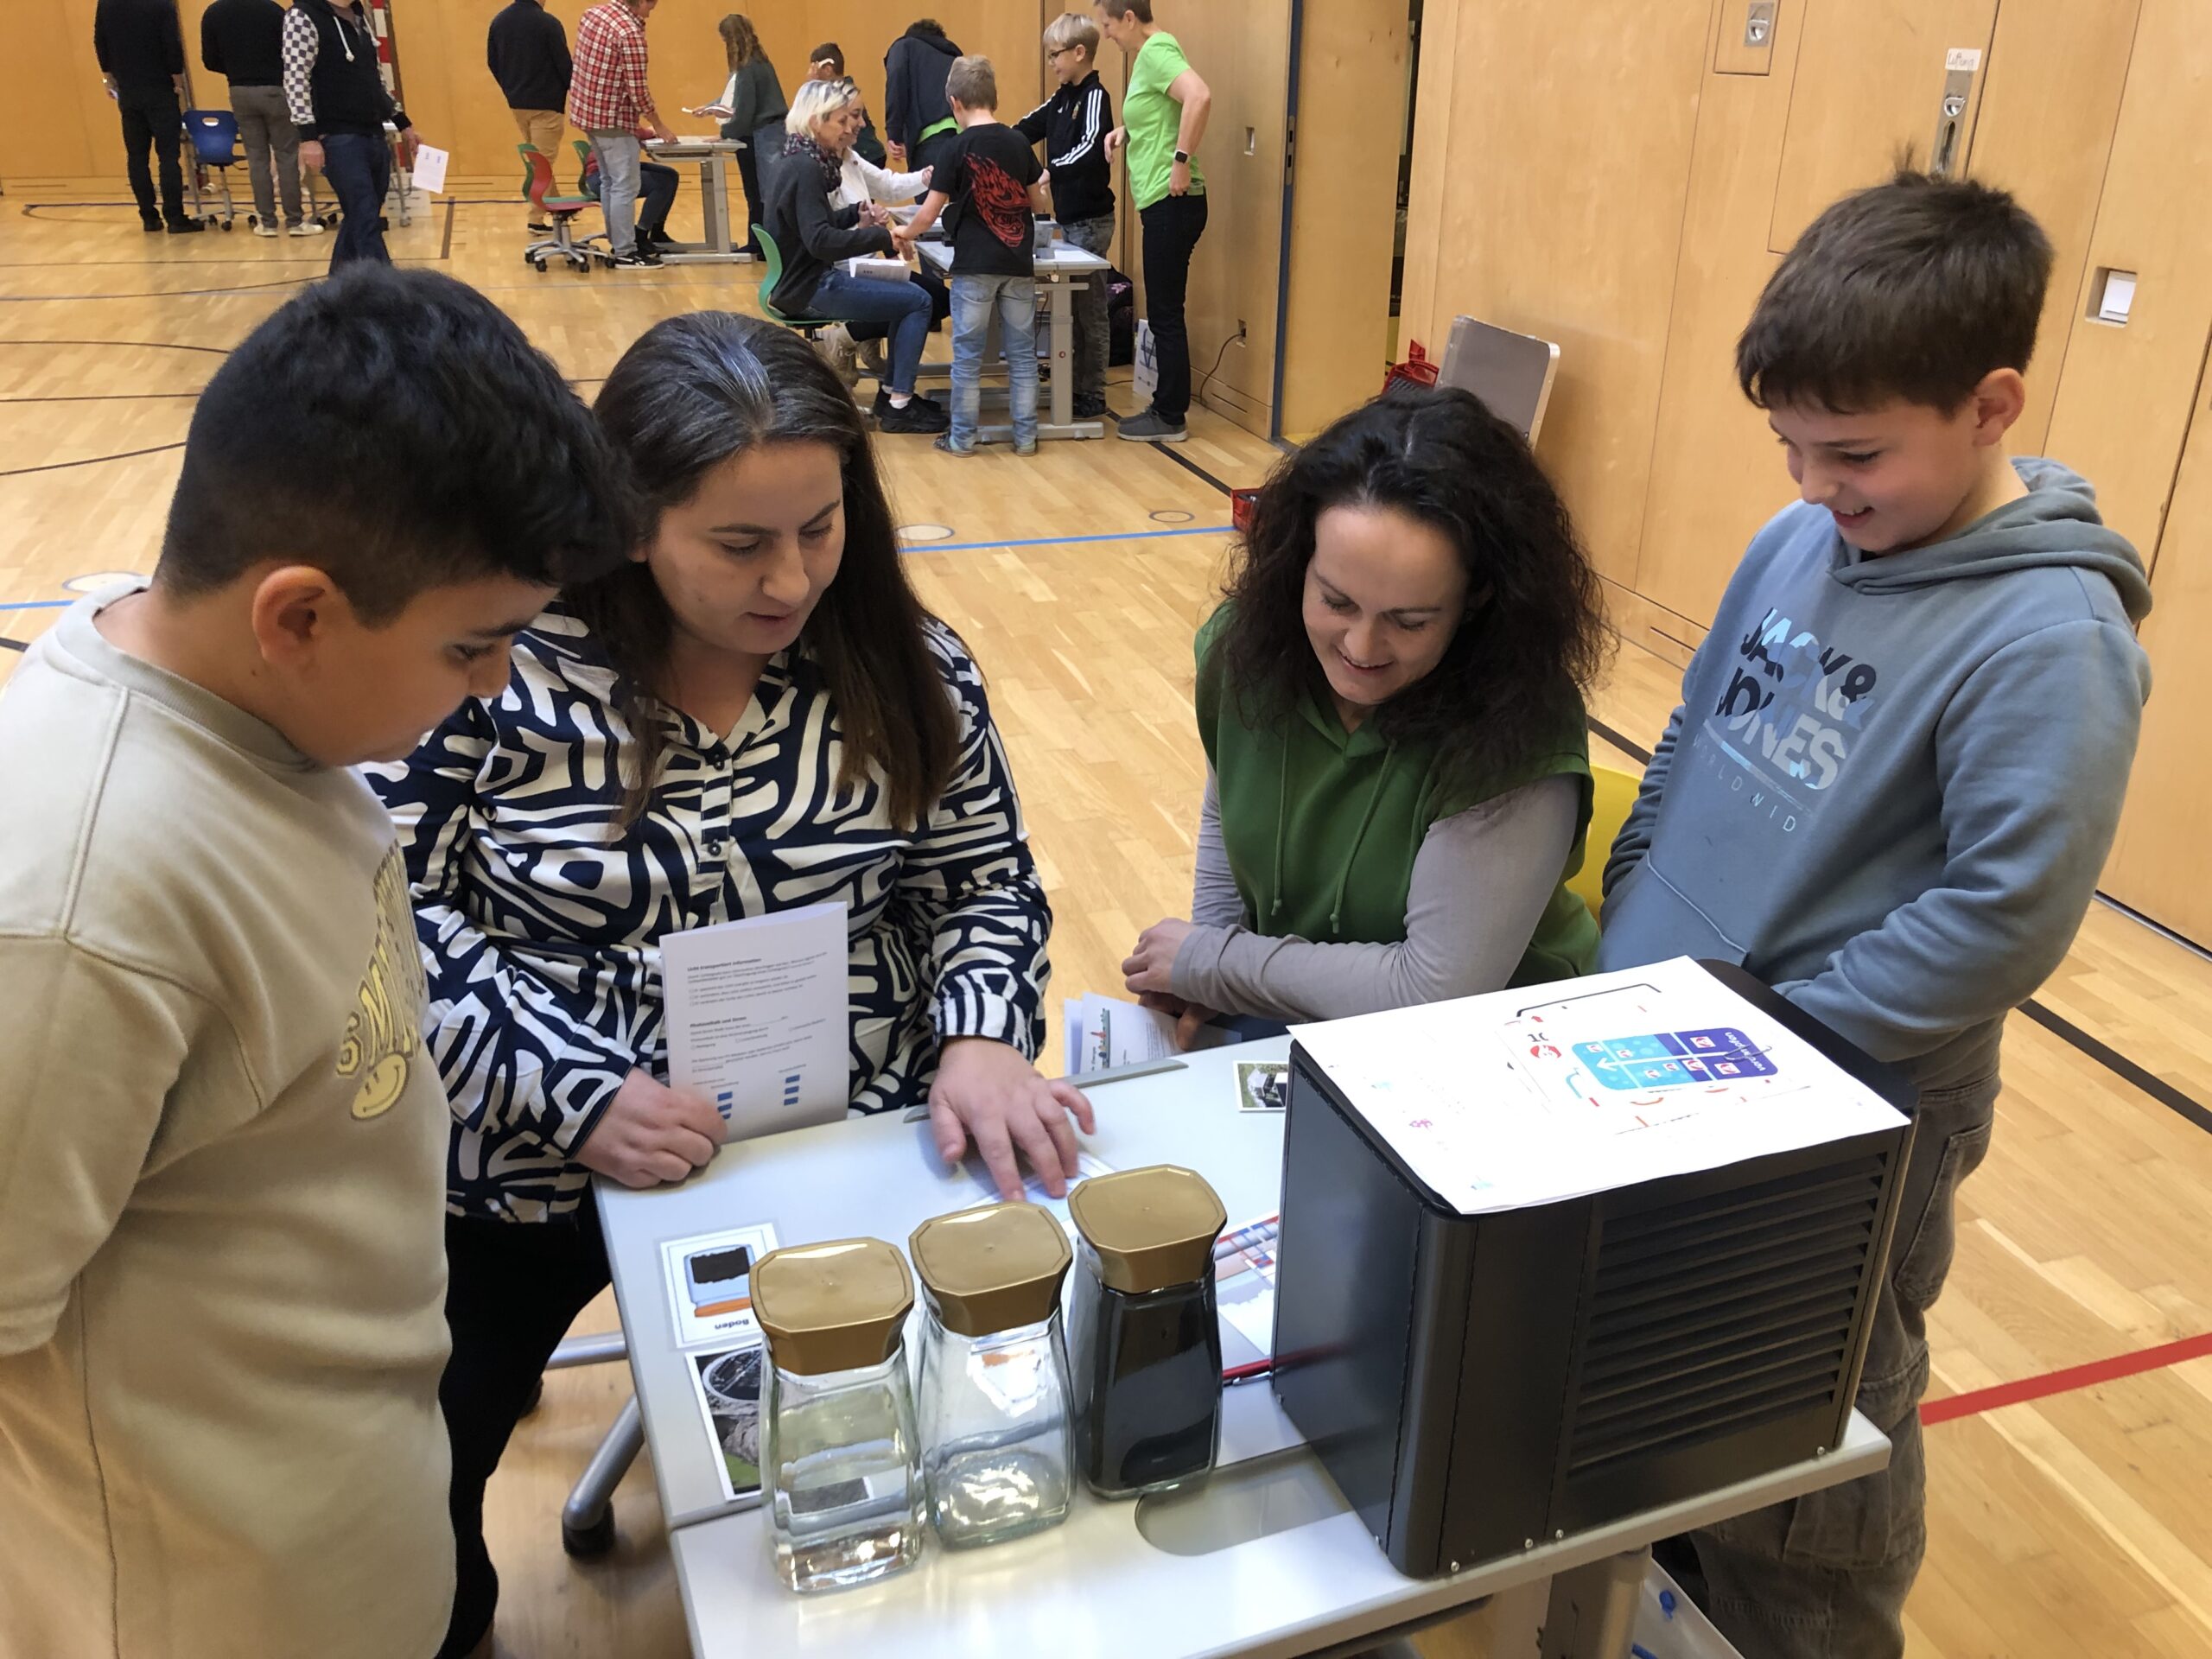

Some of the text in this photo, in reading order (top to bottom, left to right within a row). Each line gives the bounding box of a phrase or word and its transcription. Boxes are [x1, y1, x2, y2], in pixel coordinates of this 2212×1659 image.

[1715, 667, 1846, 790] JONES
[1693, 734, 1797, 832] WORLDWID
[714, 1319, 749, 1330] Boden
